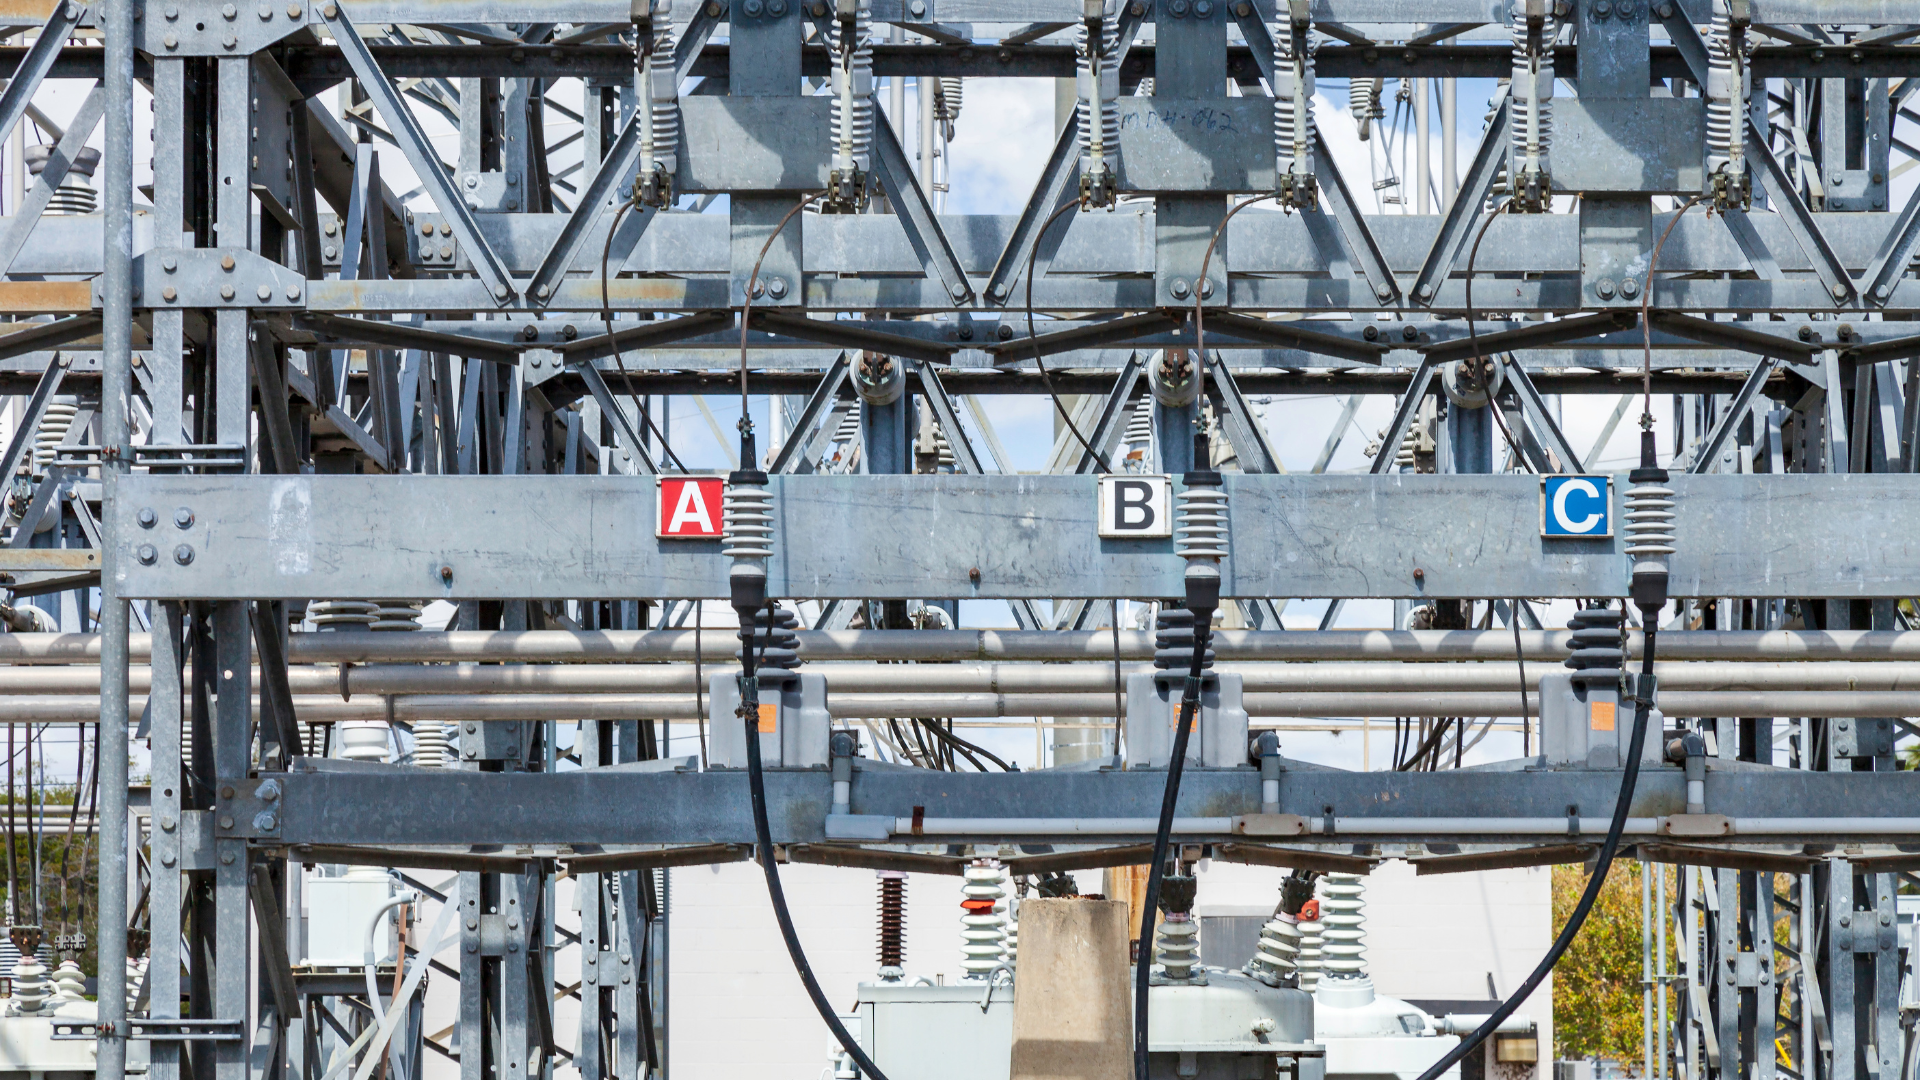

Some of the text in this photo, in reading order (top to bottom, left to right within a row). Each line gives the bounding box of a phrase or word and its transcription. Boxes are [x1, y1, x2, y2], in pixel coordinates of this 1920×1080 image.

[668, 481, 714, 532] A
[1115, 481, 1154, 529] B
[1553, 479, 1600, 533] C
